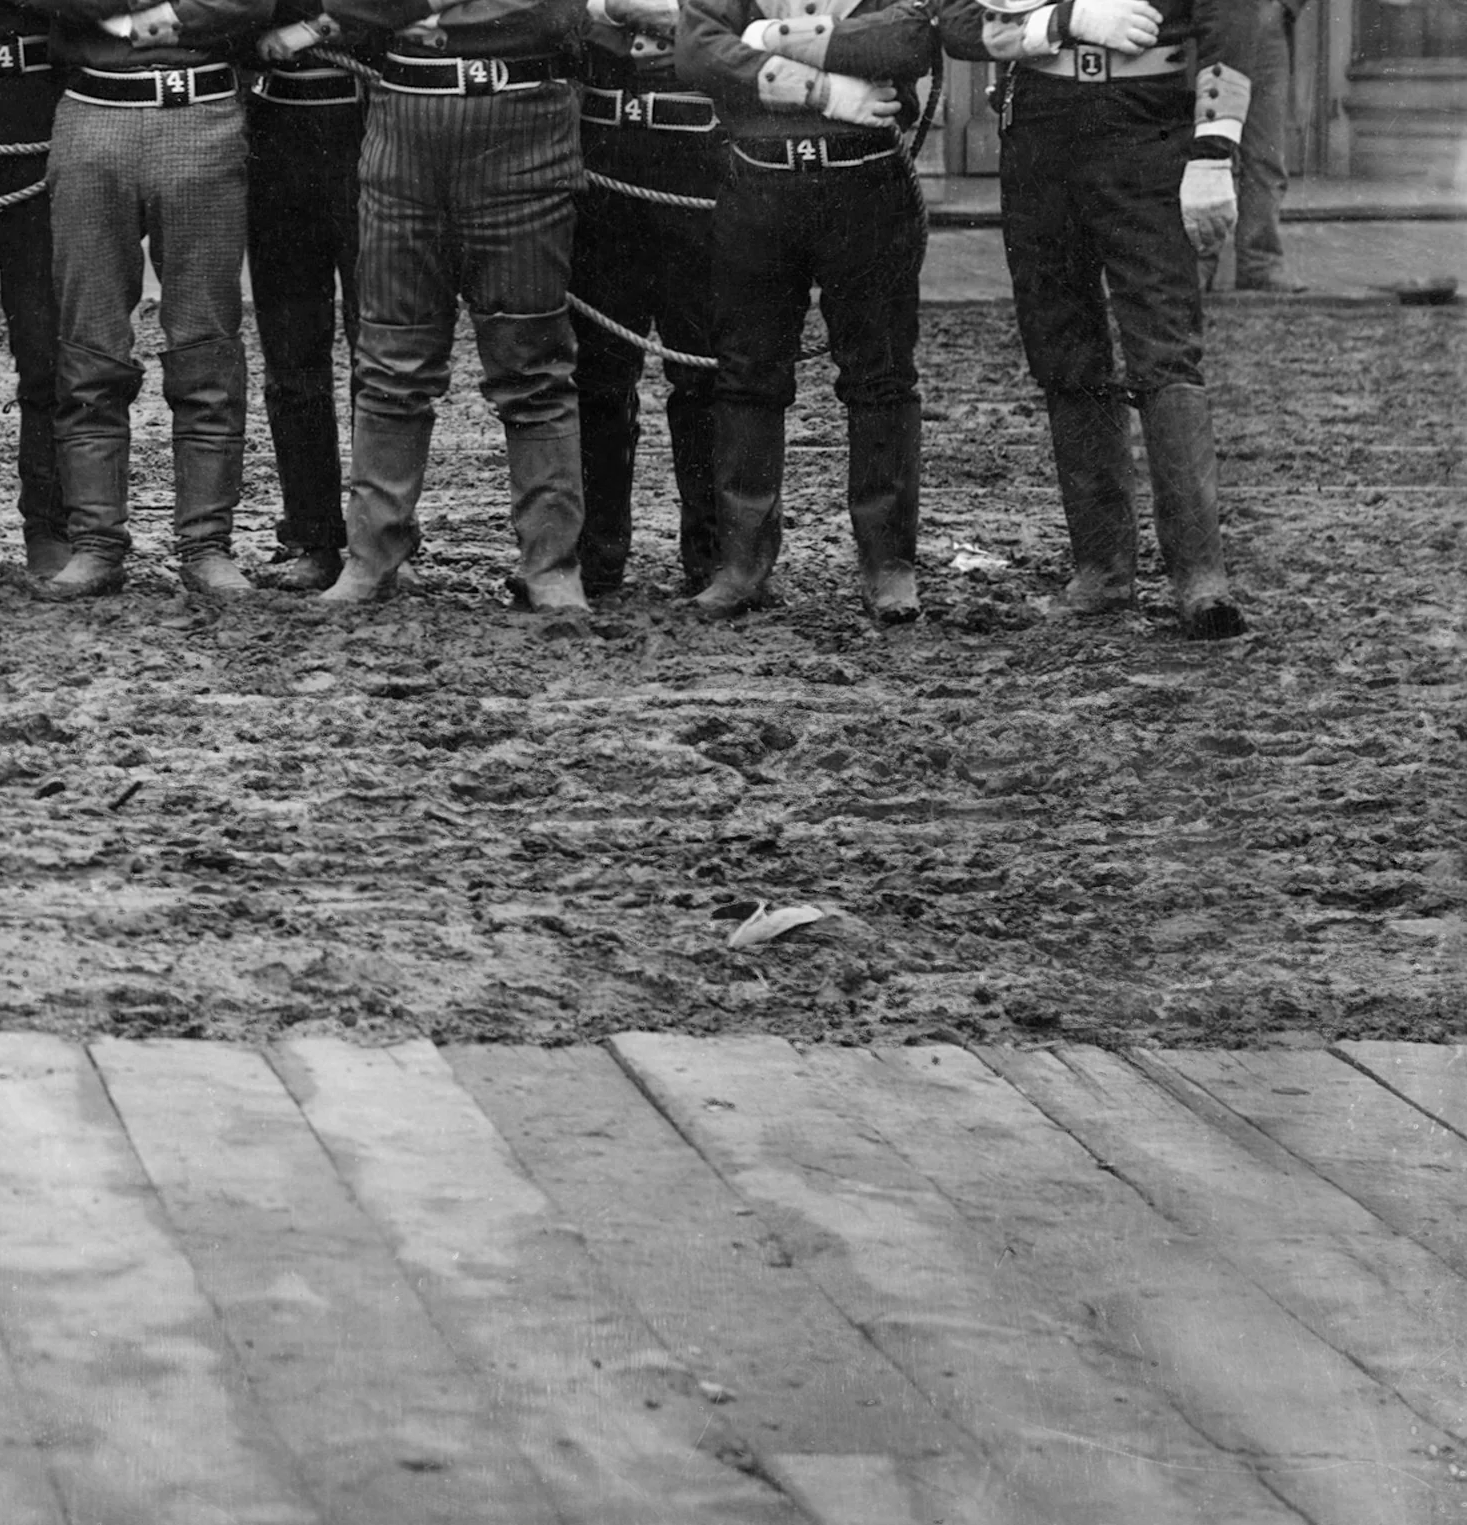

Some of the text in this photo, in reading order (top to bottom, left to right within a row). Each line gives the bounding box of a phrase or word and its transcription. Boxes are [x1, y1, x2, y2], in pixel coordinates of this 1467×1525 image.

[469, 60, 487, 83] 4
[1084, 54, 1099, 75] 1
[166, 71, 186, 94] 4
[624, 98, 643, 121] 4
[796, 139, 817, 161] 4
